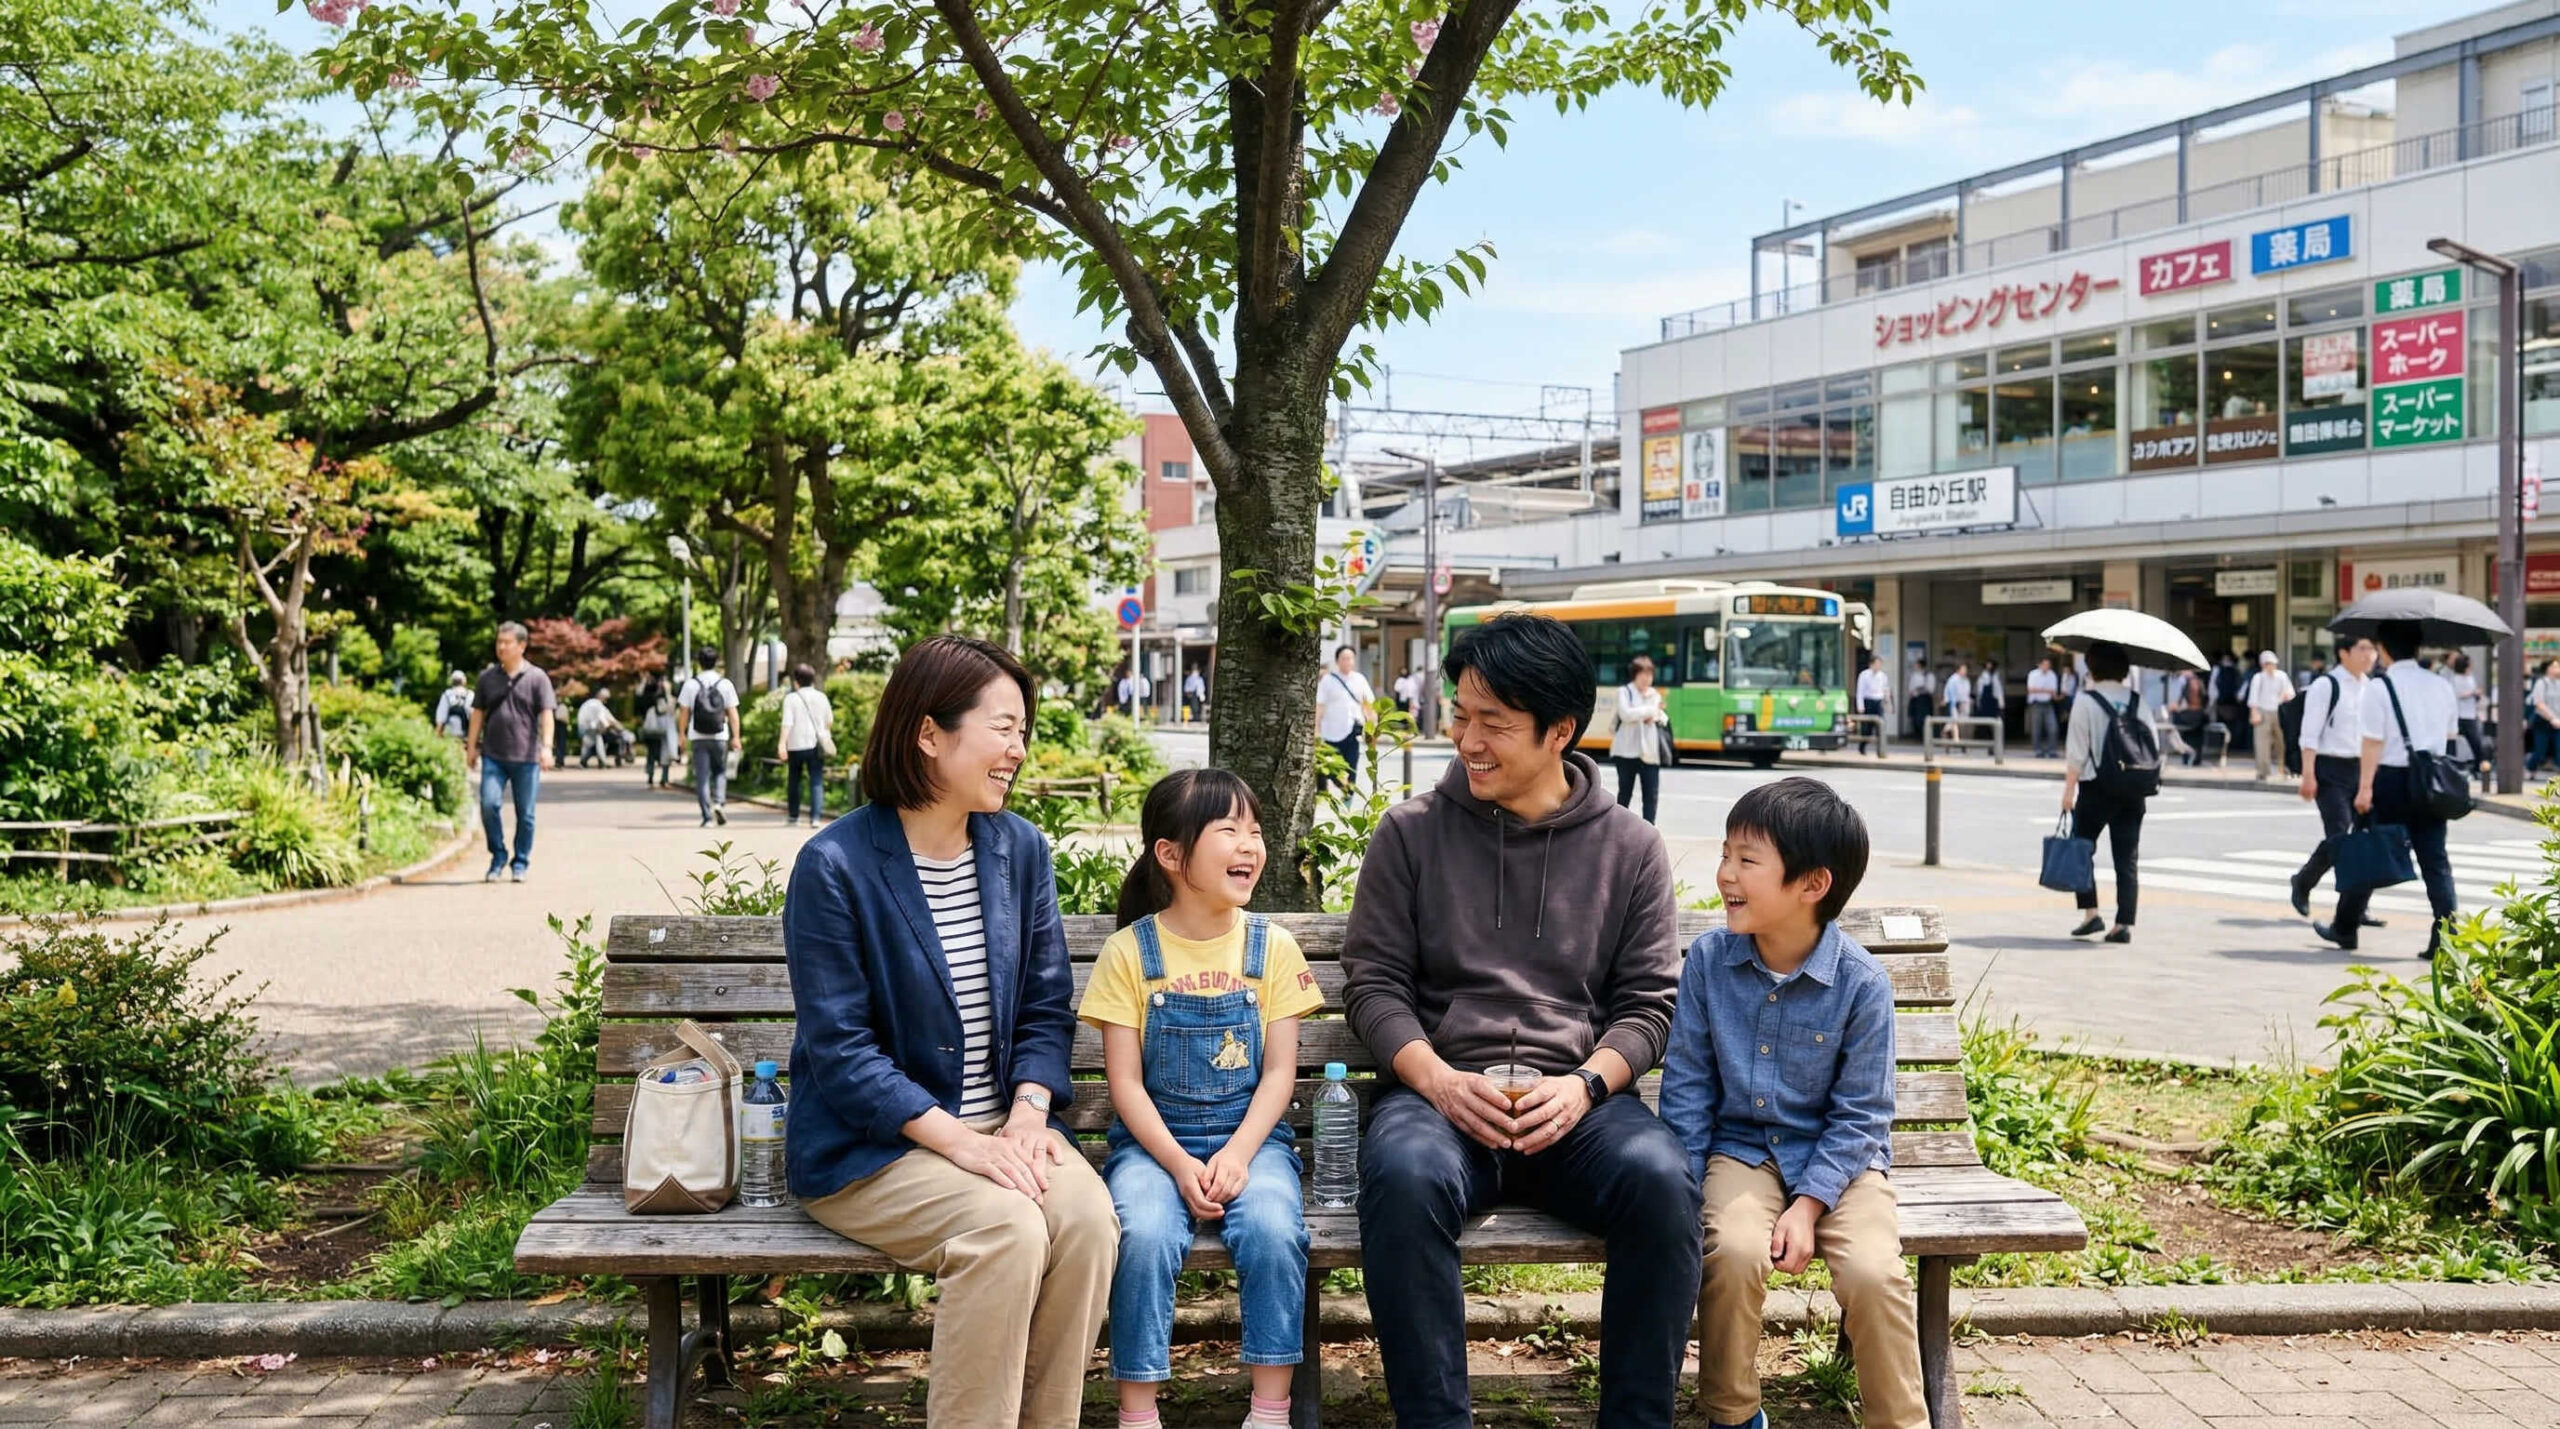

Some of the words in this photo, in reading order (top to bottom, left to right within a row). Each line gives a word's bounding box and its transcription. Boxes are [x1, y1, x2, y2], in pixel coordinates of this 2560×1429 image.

[2270, 224, 2331, 266] 薬局
[2150, 253, 2221, 290] カフェ
[1876, 270, 2119, 347] ショッピングセンター
[2380, 320, 2457, 351] スーパー
[2388, 347, 2448, 375] ホーク
[2382, 387, 2454, 415] スーパー
[2378, 412, 2459, 439] マーケット
[1842, 494, 1868, 521] JR
[1890, 477, 1987, 511] 自由が丘駅
